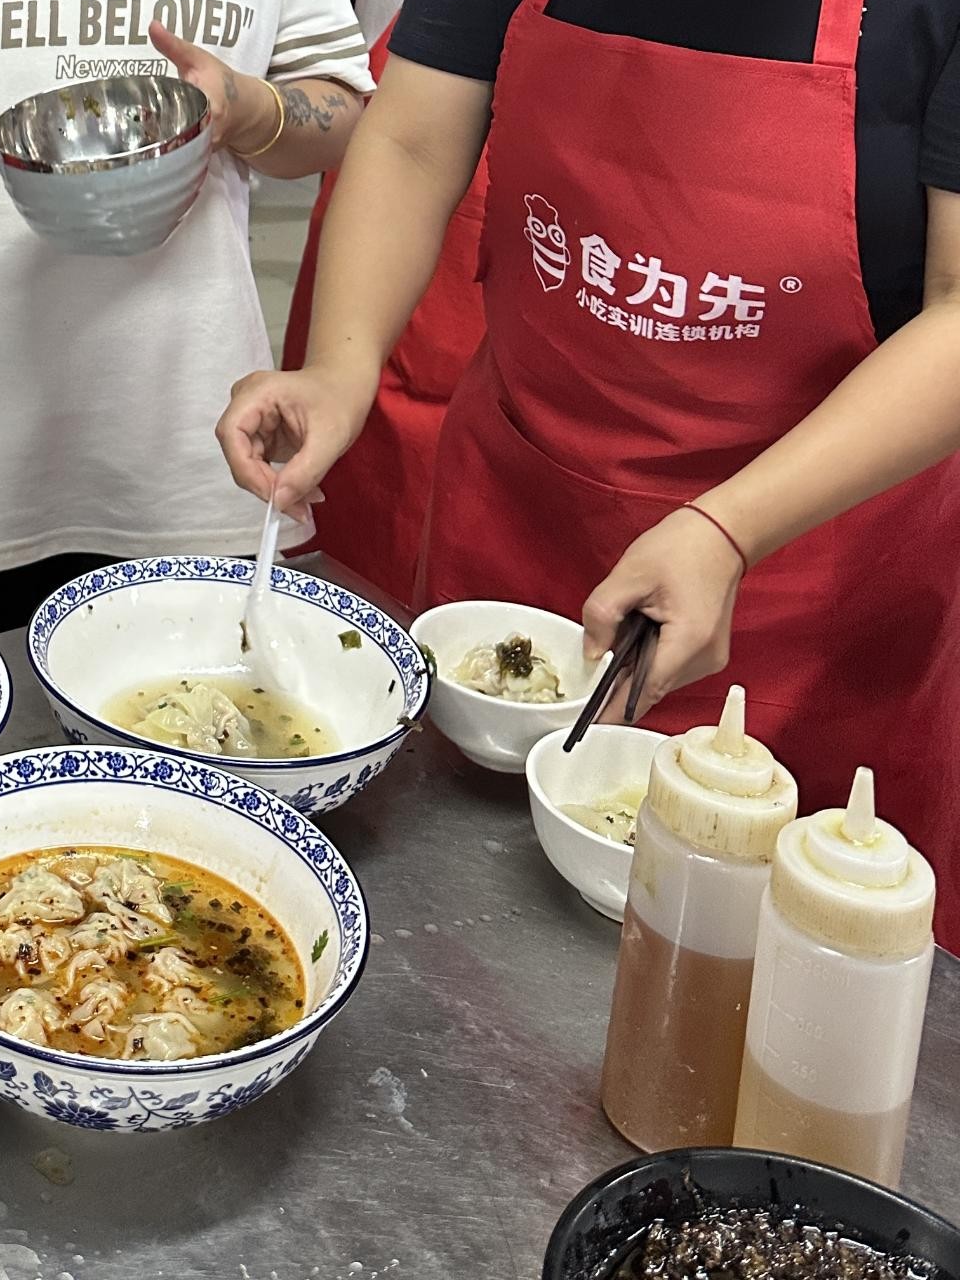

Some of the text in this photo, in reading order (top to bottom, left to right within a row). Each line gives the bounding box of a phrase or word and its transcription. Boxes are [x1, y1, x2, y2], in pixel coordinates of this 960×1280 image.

[56, 54, 168, 79] Newxazn
[579, 233, 767, 322] 食为先
[575, 287, 761, 342] 小吃实训连锁机构
